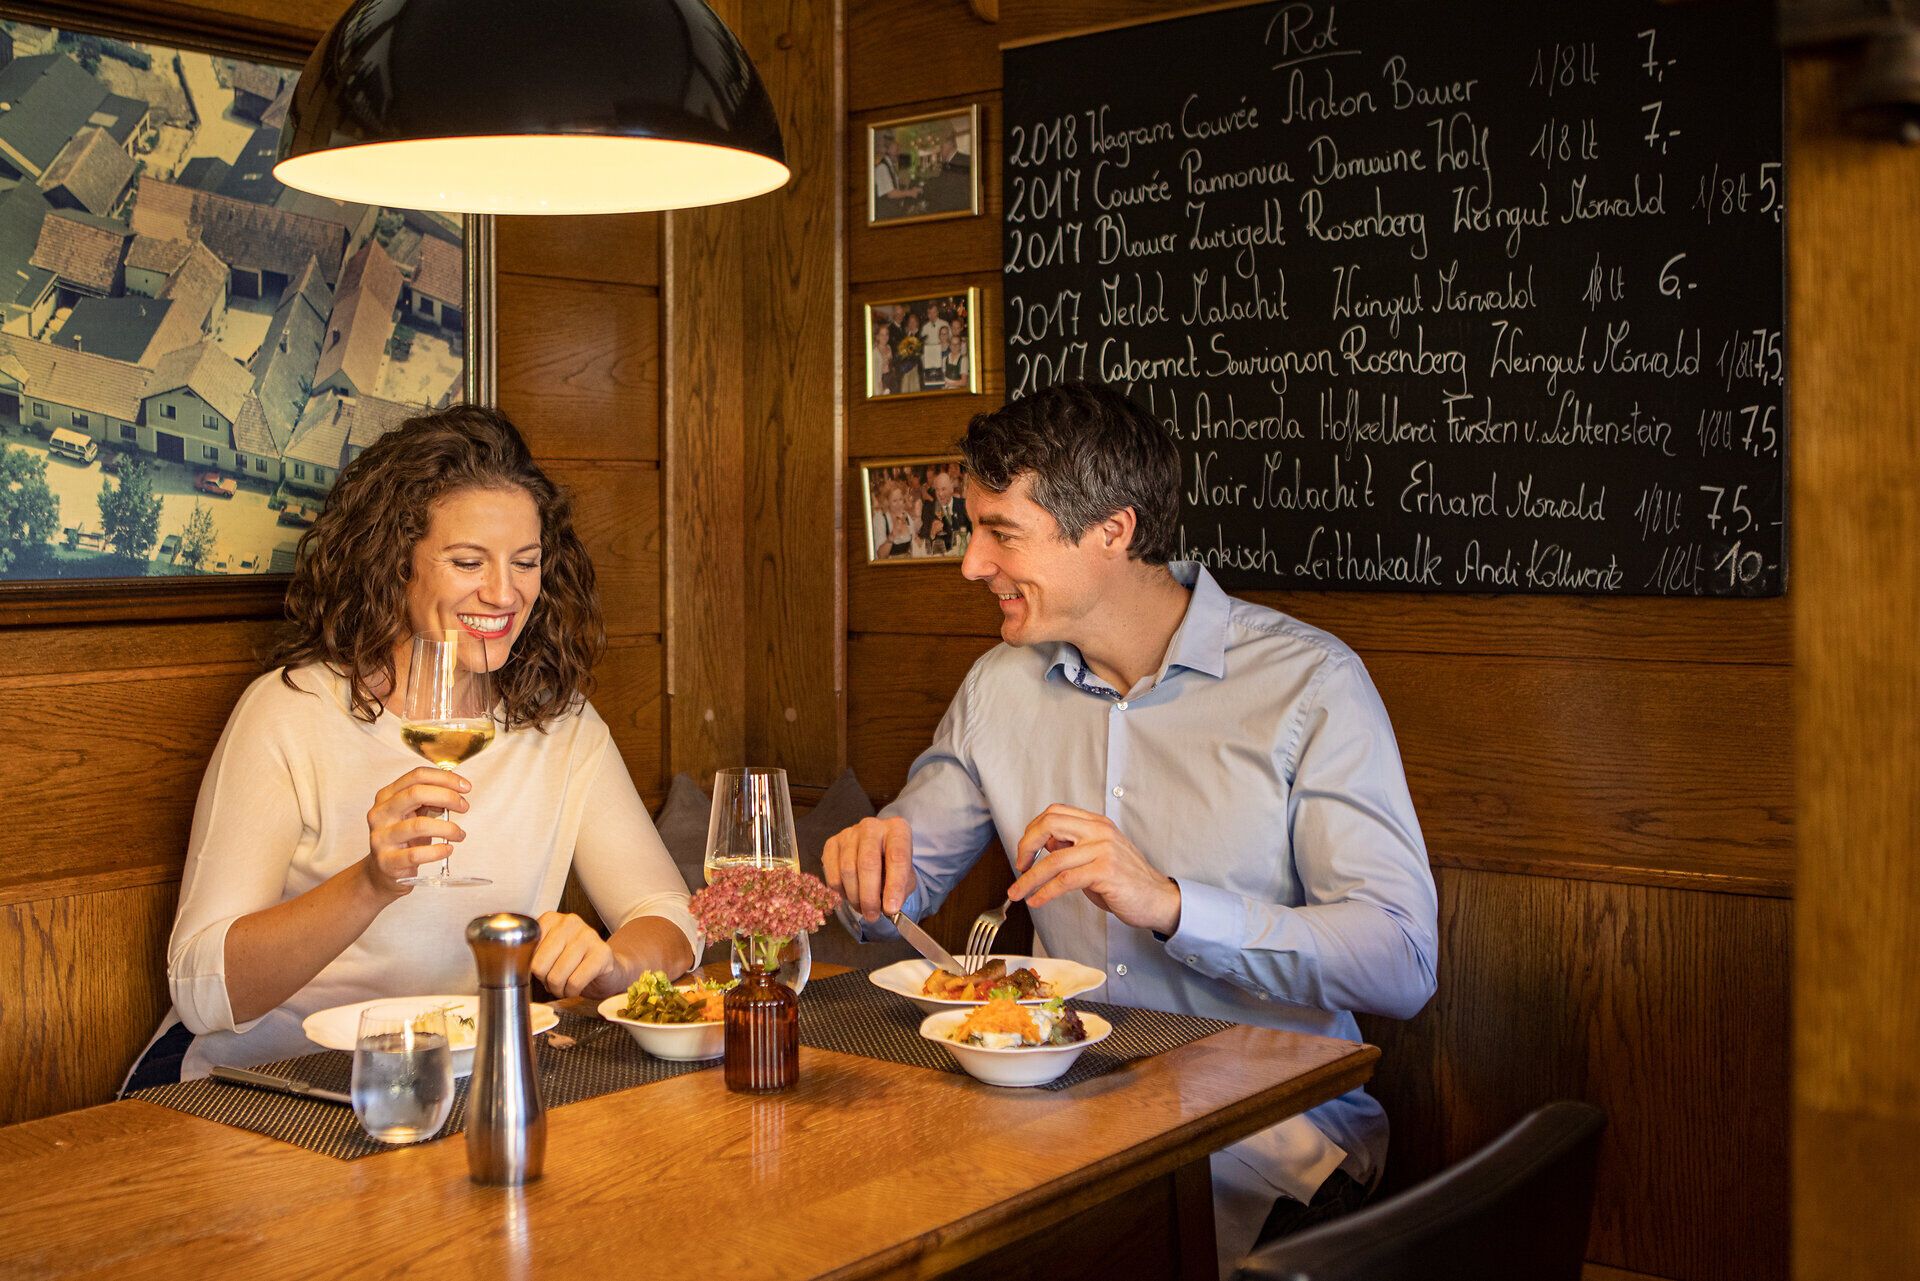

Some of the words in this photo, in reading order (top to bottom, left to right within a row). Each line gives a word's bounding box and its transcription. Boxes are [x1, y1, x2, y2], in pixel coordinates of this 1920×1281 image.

[1265, 4, 1338, 55] Rot
[1011, 114, 1078, 168] 2018
[1086, 104, 1174, 168] Wagram
[1282, 68, 1377, 123] Anton
[1383, 55, 1478, 110] Bauer
[1007, 168, 1081, 222] 2017
[1180, 149, 1294, 195] Pannonica
[1308, 135, 1426, 186] Domaine
[1426, 112, 1493, 214] Wolf
[1004, 222, 1083, 273] 2017
[1094, 213, 1178, 264] Blauer
[1300, 186, 1428, 260] Rosenberg
[1452, 183, 1550, 259] Weingut
[1009, 290, 1081, 345] 2017
[1100, 272, 1169, 327] Merlot
[1182, 267, 1289, 327] Malachit
[1333, 264, 1424, 339] Weingut
[1012, 342, 1088, 400] 2017
[1100, 333, 1201, 384] Cabernet
[1340, 325, 1467, 398] Rosenberg
[1491, 320, 1585, 397] Weingut
[1320, 387, 1437, 462] Hofkellerei
[1188, 451, 1247, 506] Noir
[1253, 451, 1374, 511] Malachit
[1400, 460, 1499, 518] Erhard
[1295, 526, 1442, 586] Leithakalk
[1456, 540, 1520, 587] Andi
